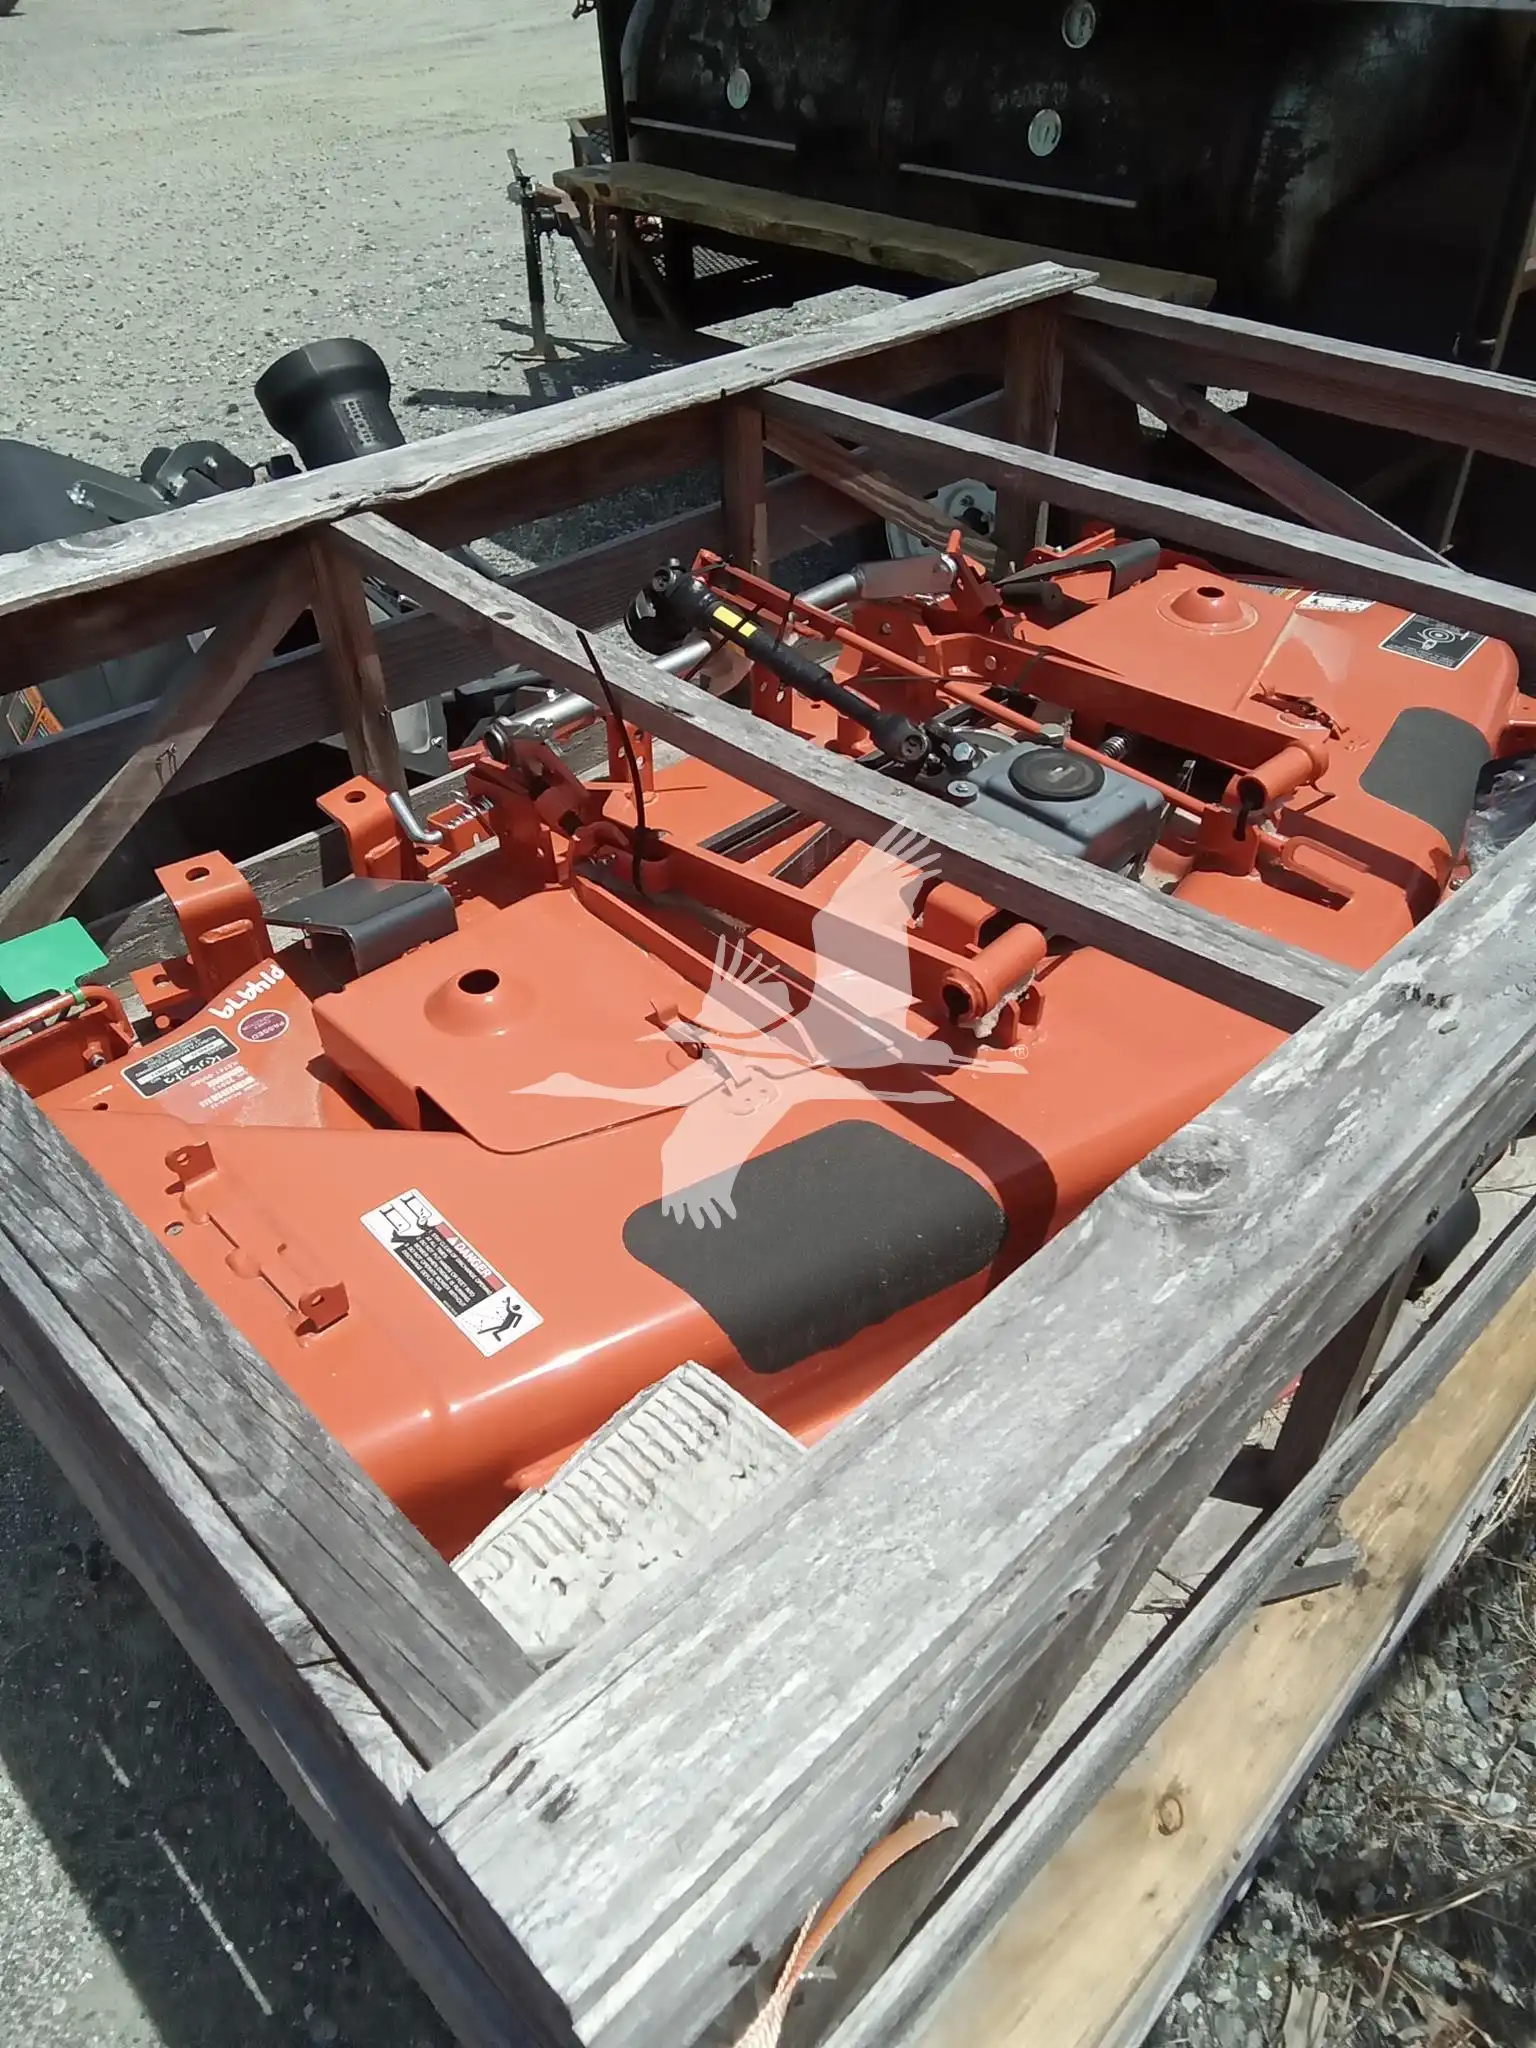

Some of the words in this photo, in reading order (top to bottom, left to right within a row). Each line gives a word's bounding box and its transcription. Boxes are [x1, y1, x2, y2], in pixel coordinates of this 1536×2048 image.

[252, 1020, 285, 1040] PASSED
[162, 1052, 222, 1087] Kubota
[453, 1241, 492, 1278] DANGER
